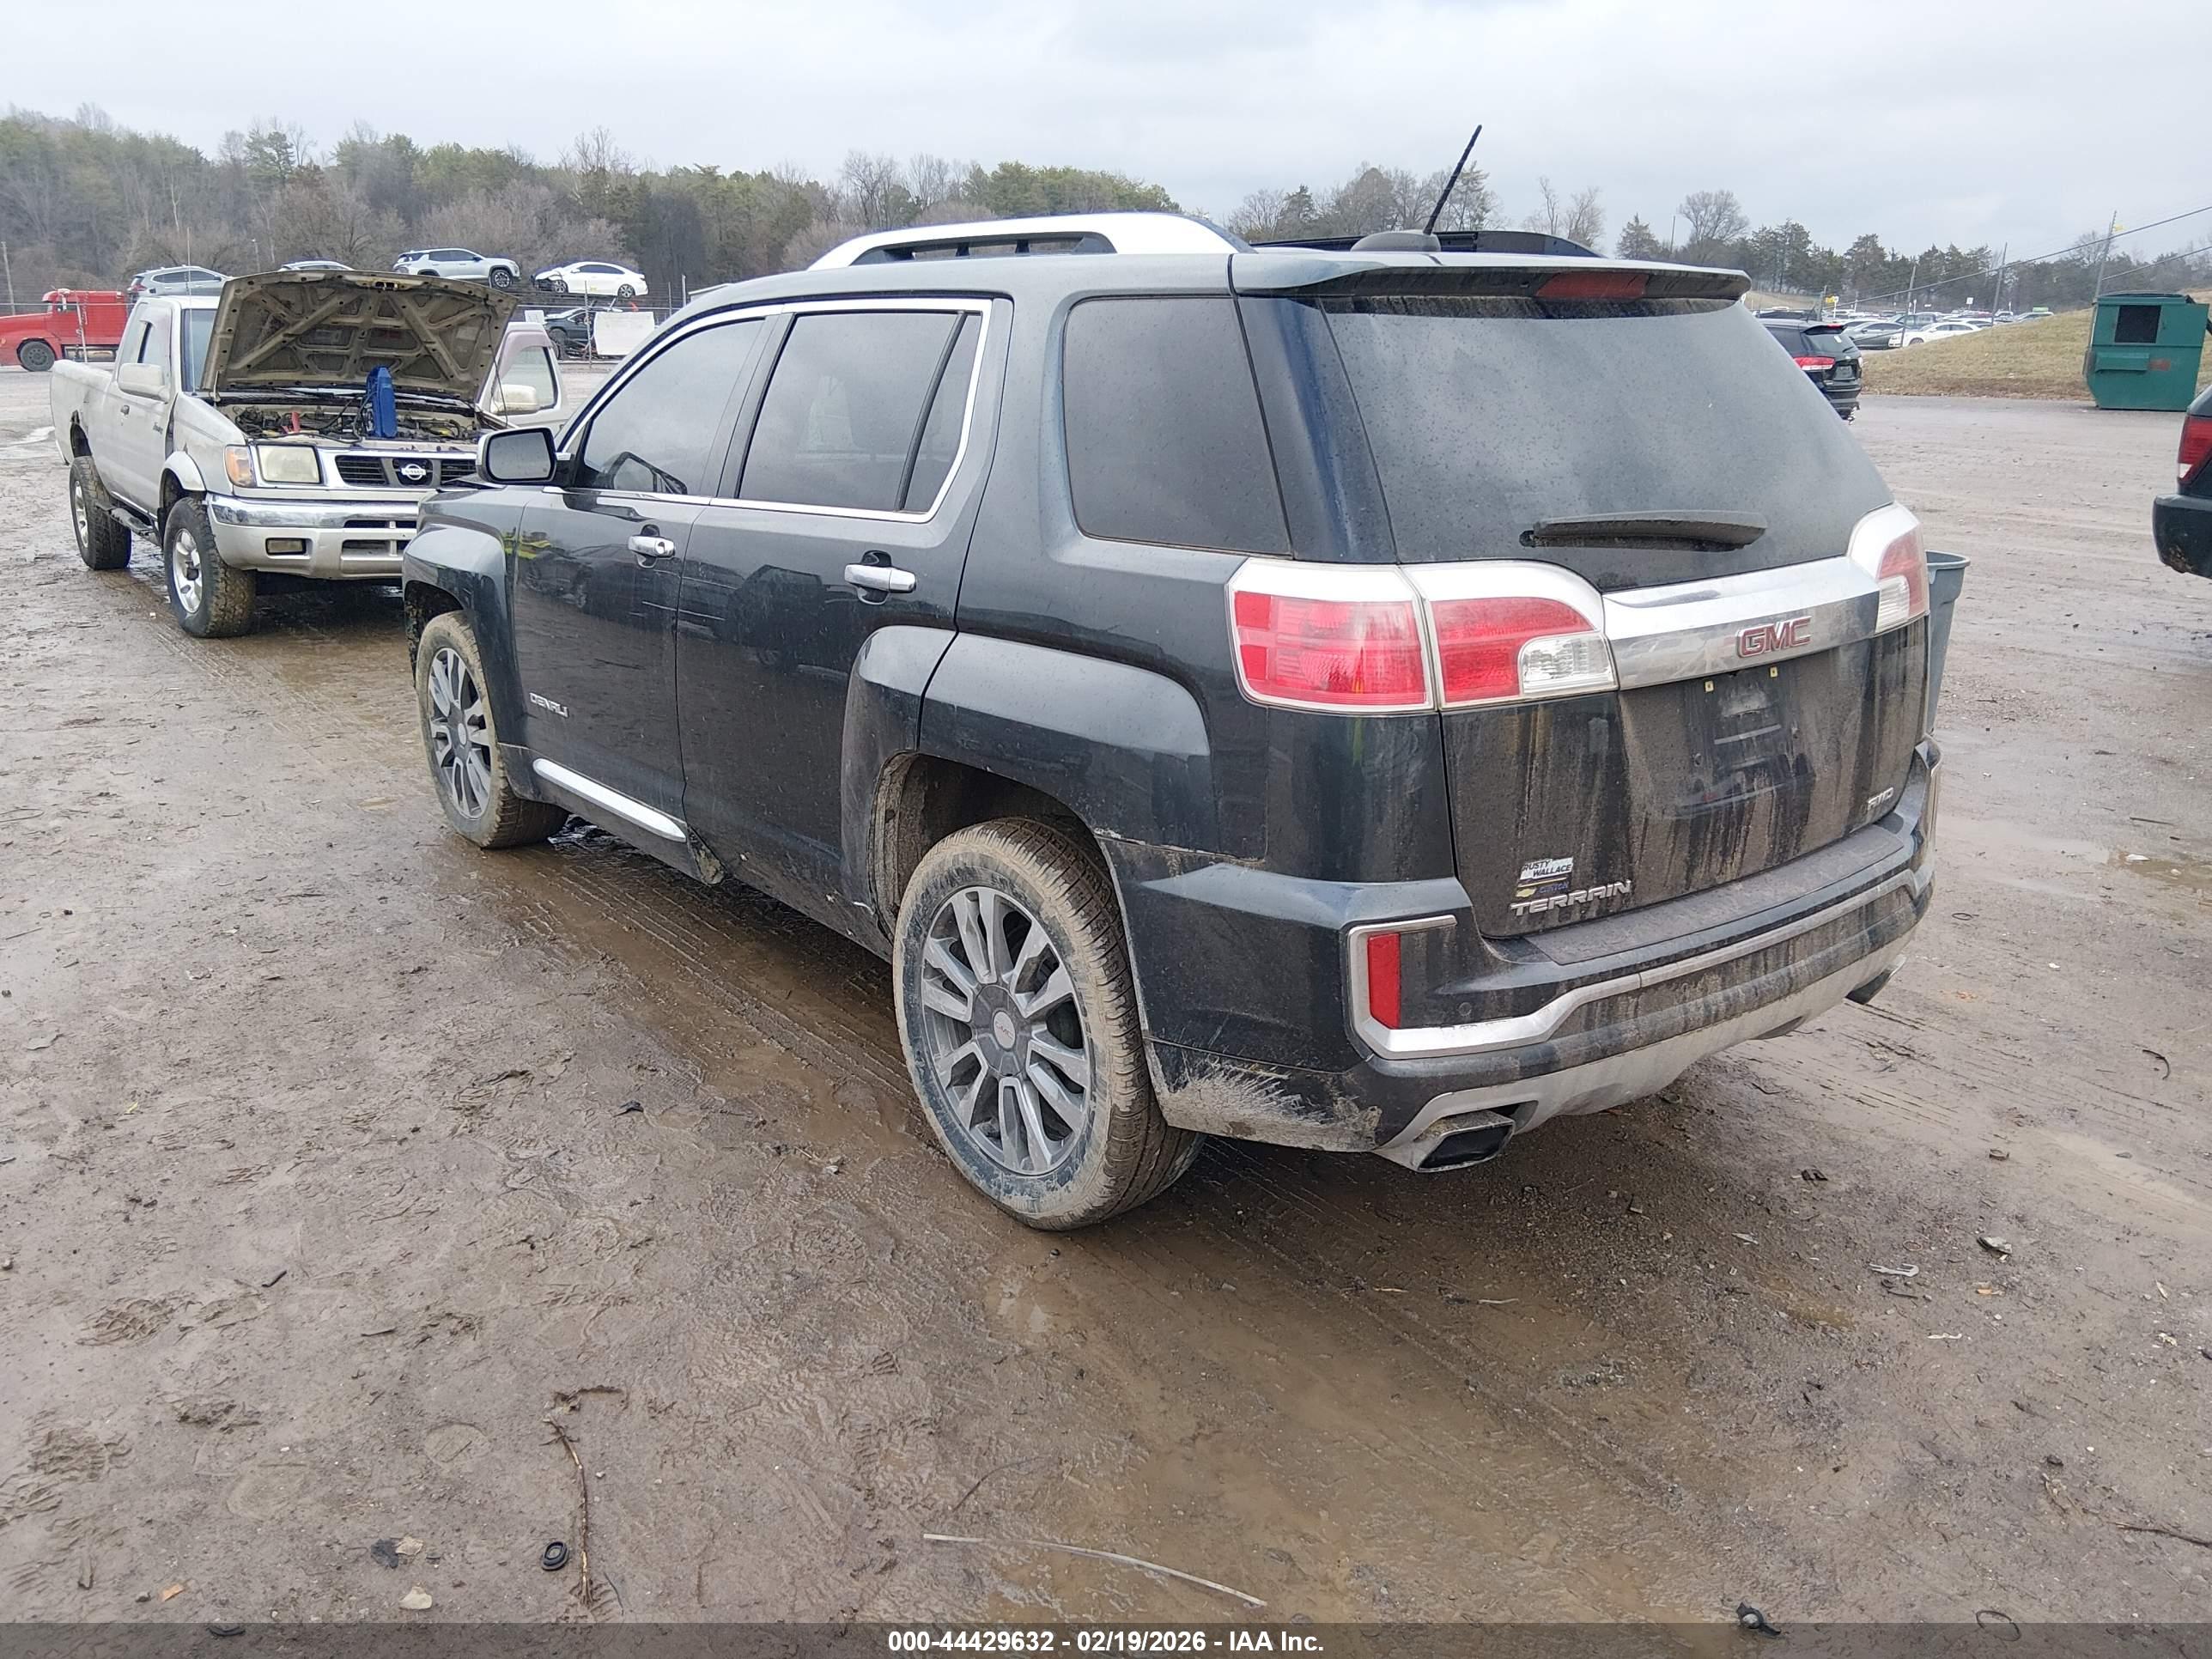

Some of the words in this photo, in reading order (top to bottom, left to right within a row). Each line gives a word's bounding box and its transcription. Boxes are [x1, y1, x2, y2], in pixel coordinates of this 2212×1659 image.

[1735, 616, 1813, 658] GMC
[528, 692, 569, 719] DENALI
[1522, 860, 1551, 872] RUSTY
[1533, 864, 1572, 877] WALLACE
[1510, 878, 1632, 917] TERRAIN
